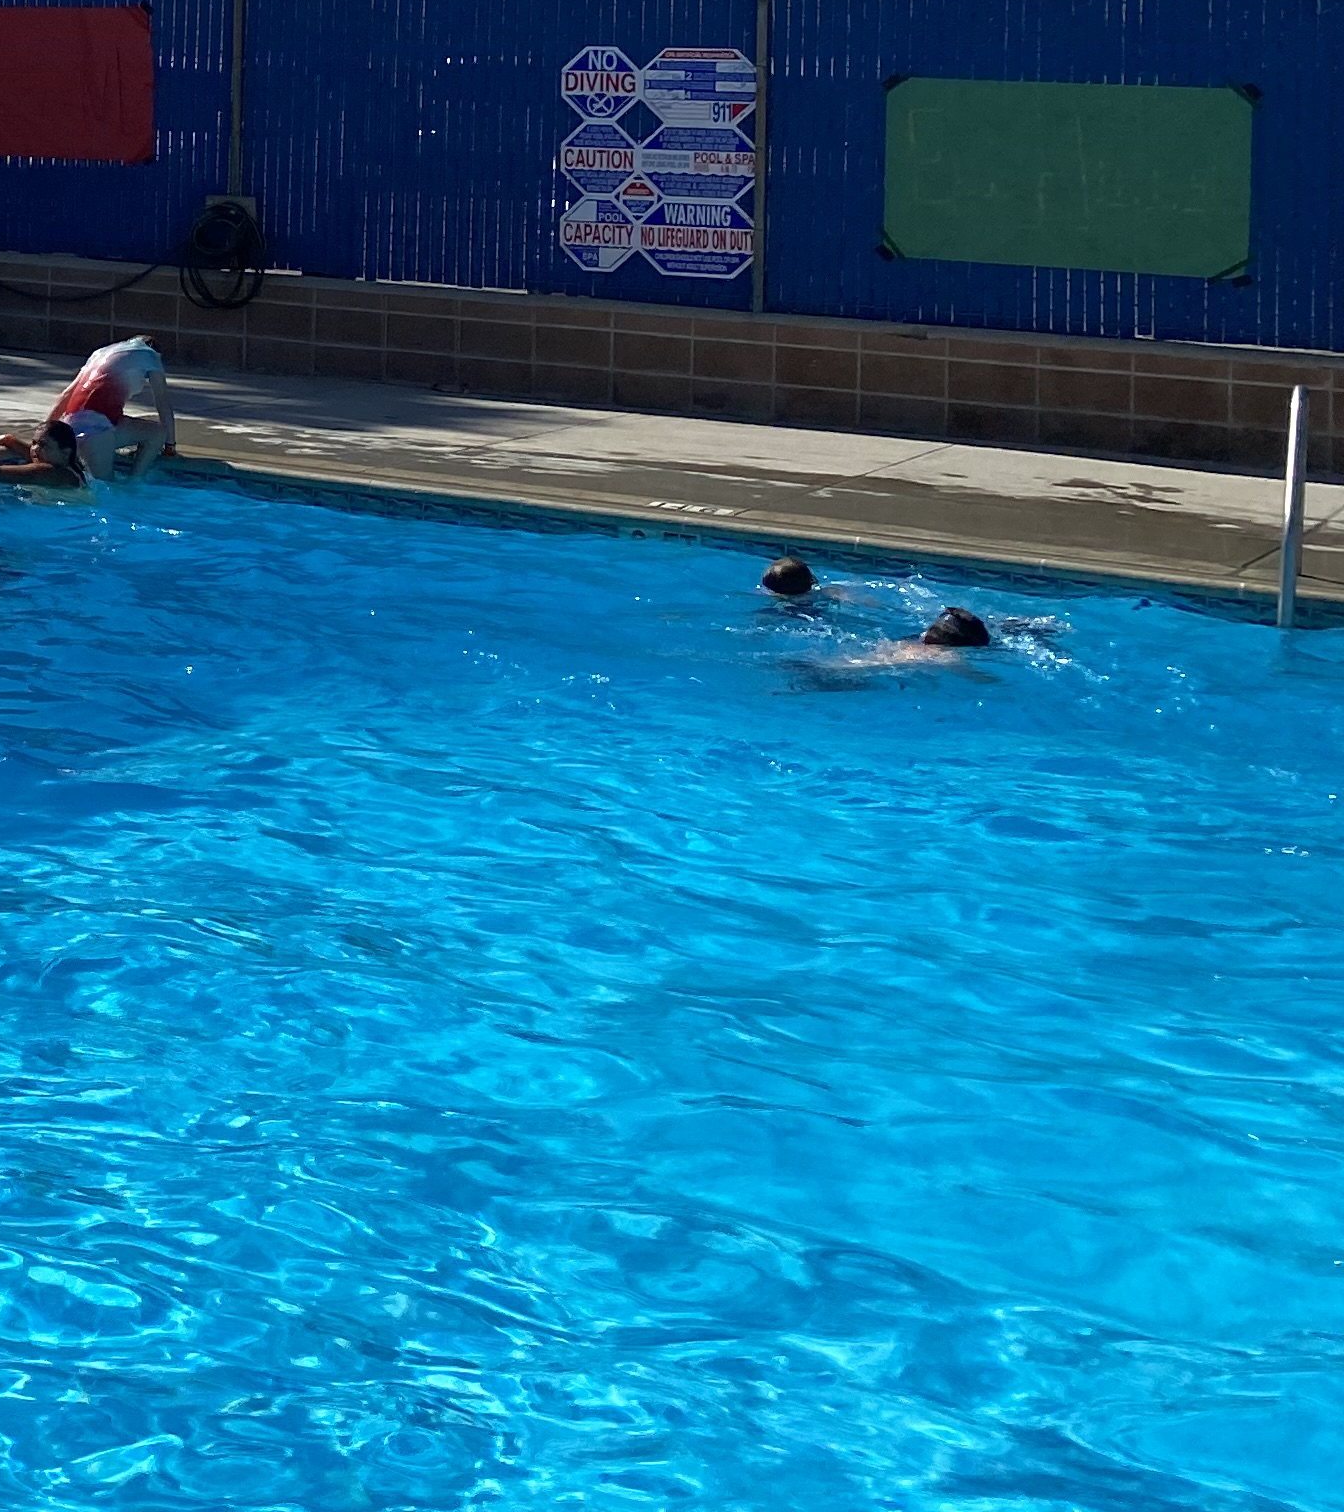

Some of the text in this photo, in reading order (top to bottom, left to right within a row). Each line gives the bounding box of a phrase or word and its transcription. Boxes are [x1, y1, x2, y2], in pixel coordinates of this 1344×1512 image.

[588, 50, 618, 71] NO
[564, 72, 637, 94] DIVING
[685, 71, 693, 81] 2
[712, 102, 732, 123] 911
[564, 148, 634, 169] CAUTION
[693, 151, 723, 164] POOL
[724, 155, 733, 165] &
[734, 153, 756, 165] SPA
[598, 212, 626, 223] POOL
[663, 203, 732, 227] WARNING
[563, 223, 634, 245] CAPACITY
[640, 226, 655, 246] NO
[658, 227, 709, 249] LIFEGUARD
[712, 229, 726, 250] ON
